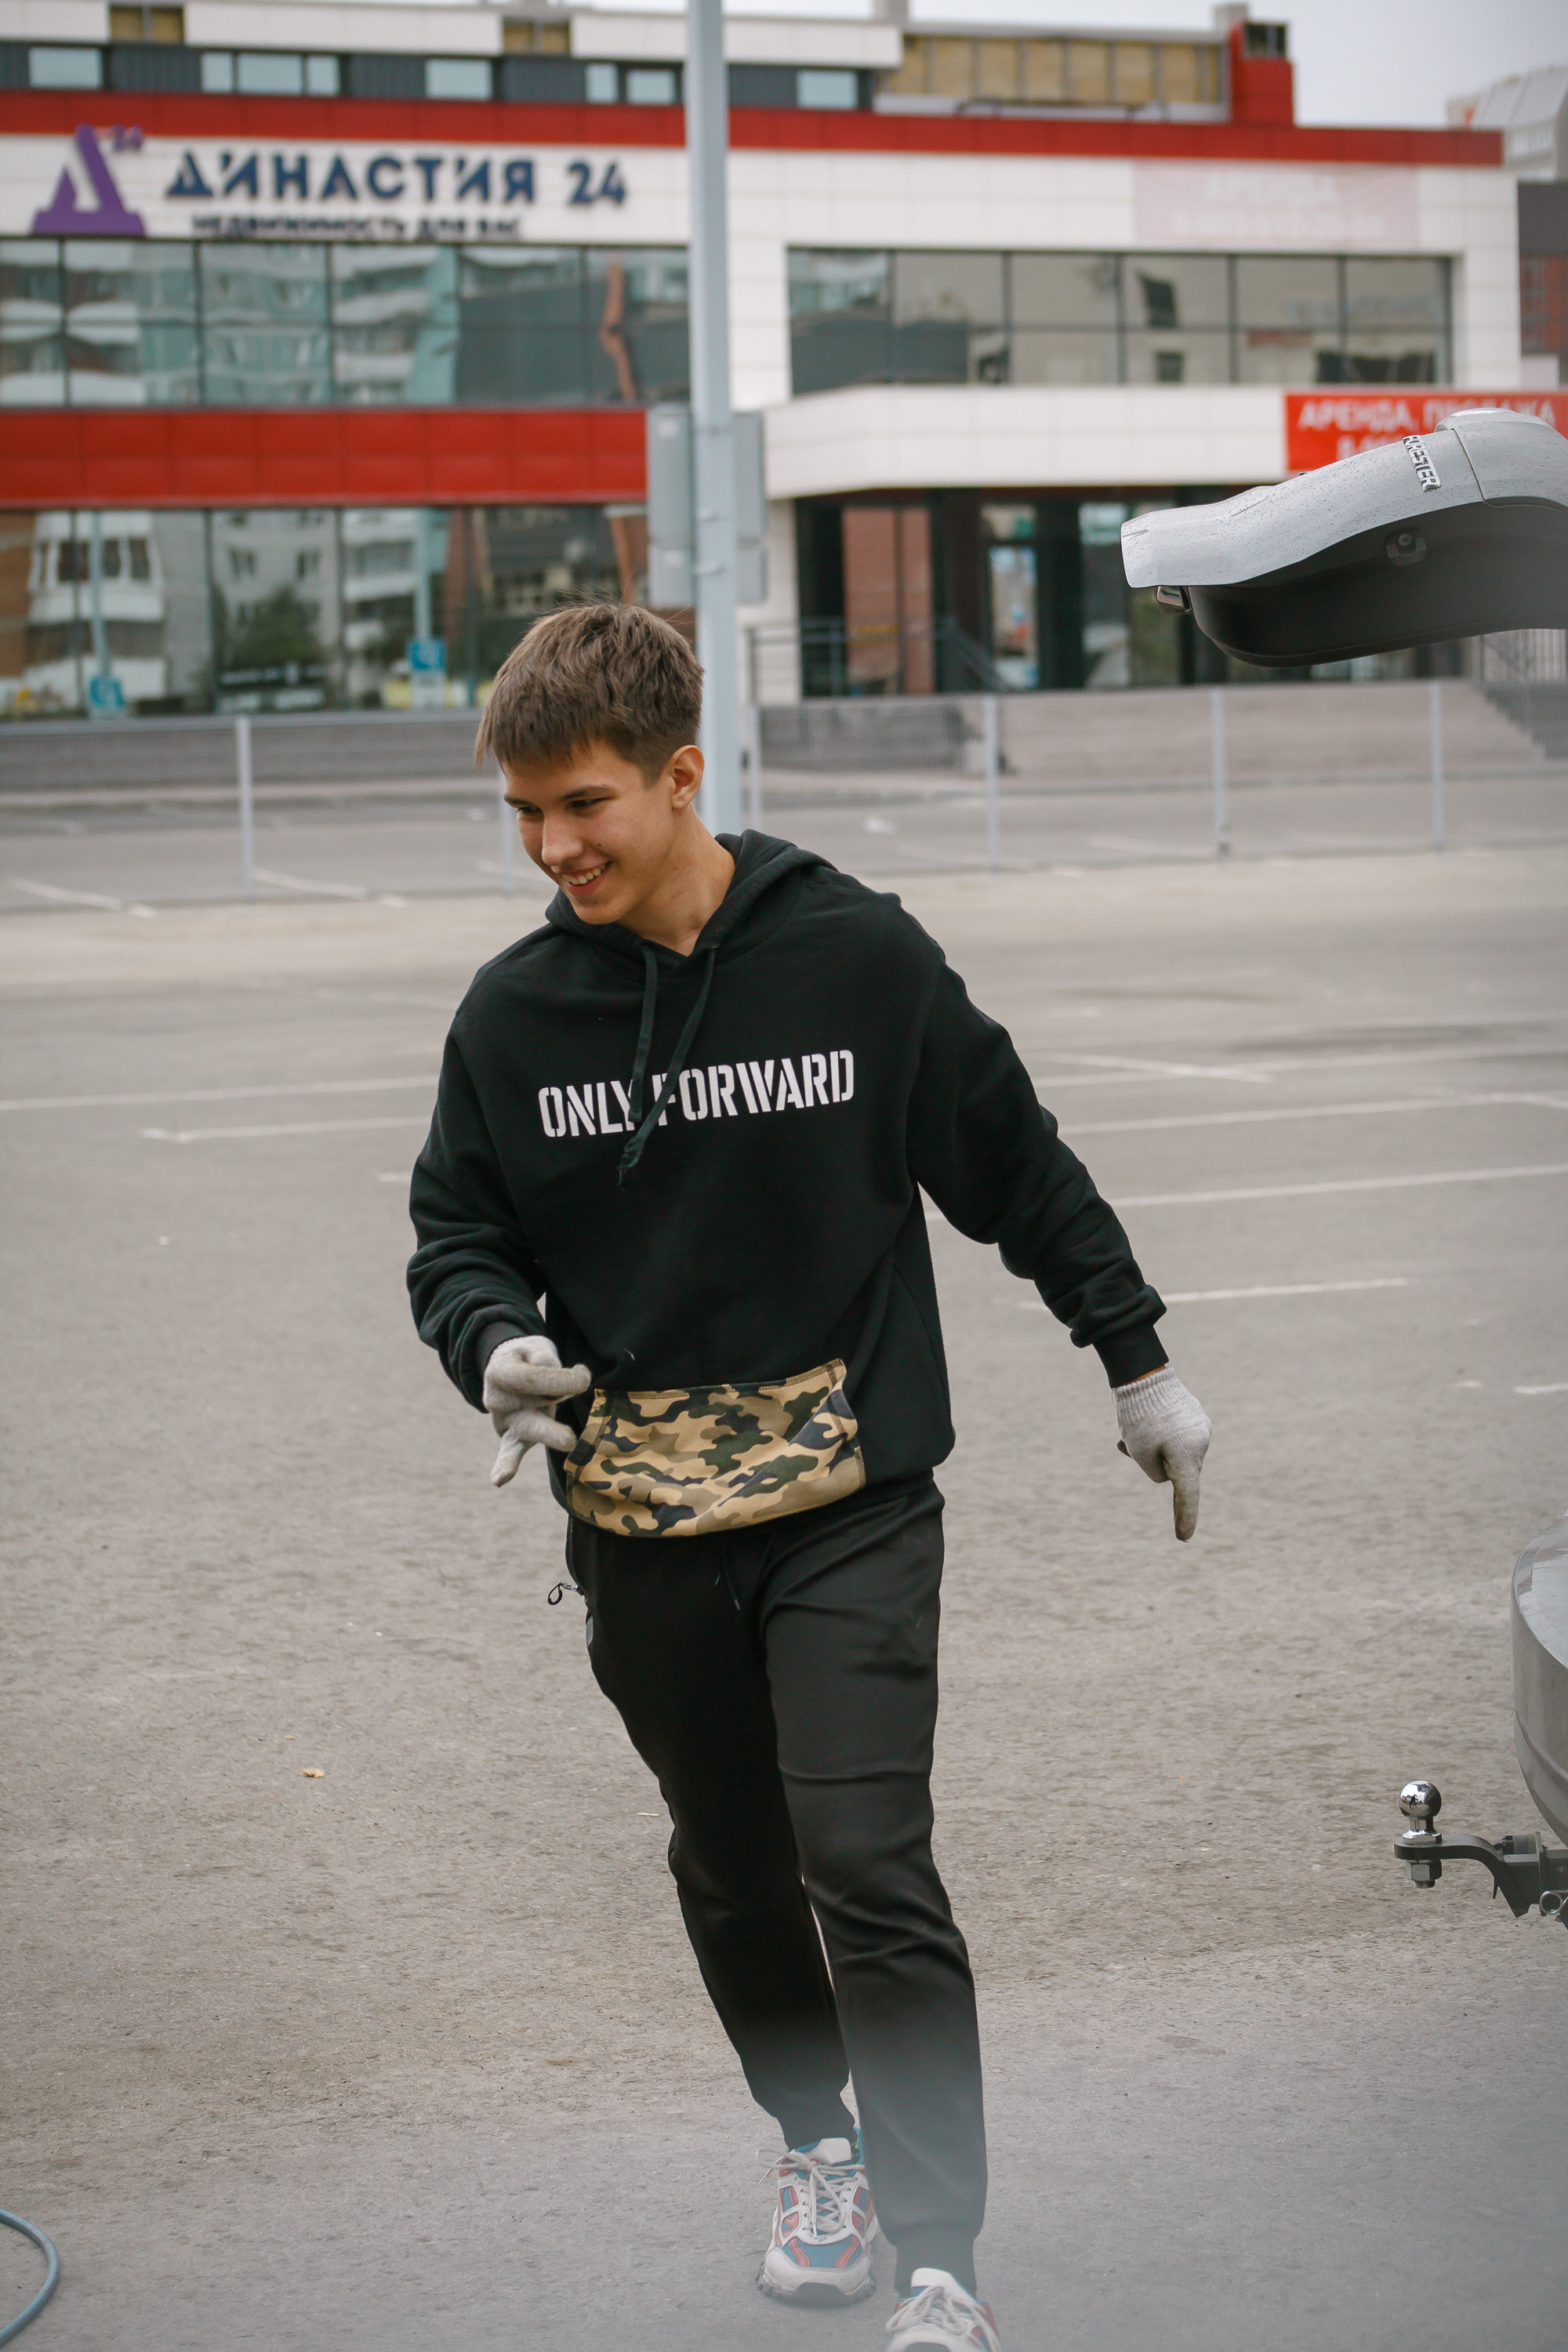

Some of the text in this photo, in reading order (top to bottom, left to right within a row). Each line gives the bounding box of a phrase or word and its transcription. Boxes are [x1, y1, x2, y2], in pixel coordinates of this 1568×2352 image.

[162, 149, 628, 207] ДИНАСТИЯ 24
[1403, 434, 1441, 492] FORESTER
[538, 1049, 855, 1138] ONLY FORWARD
